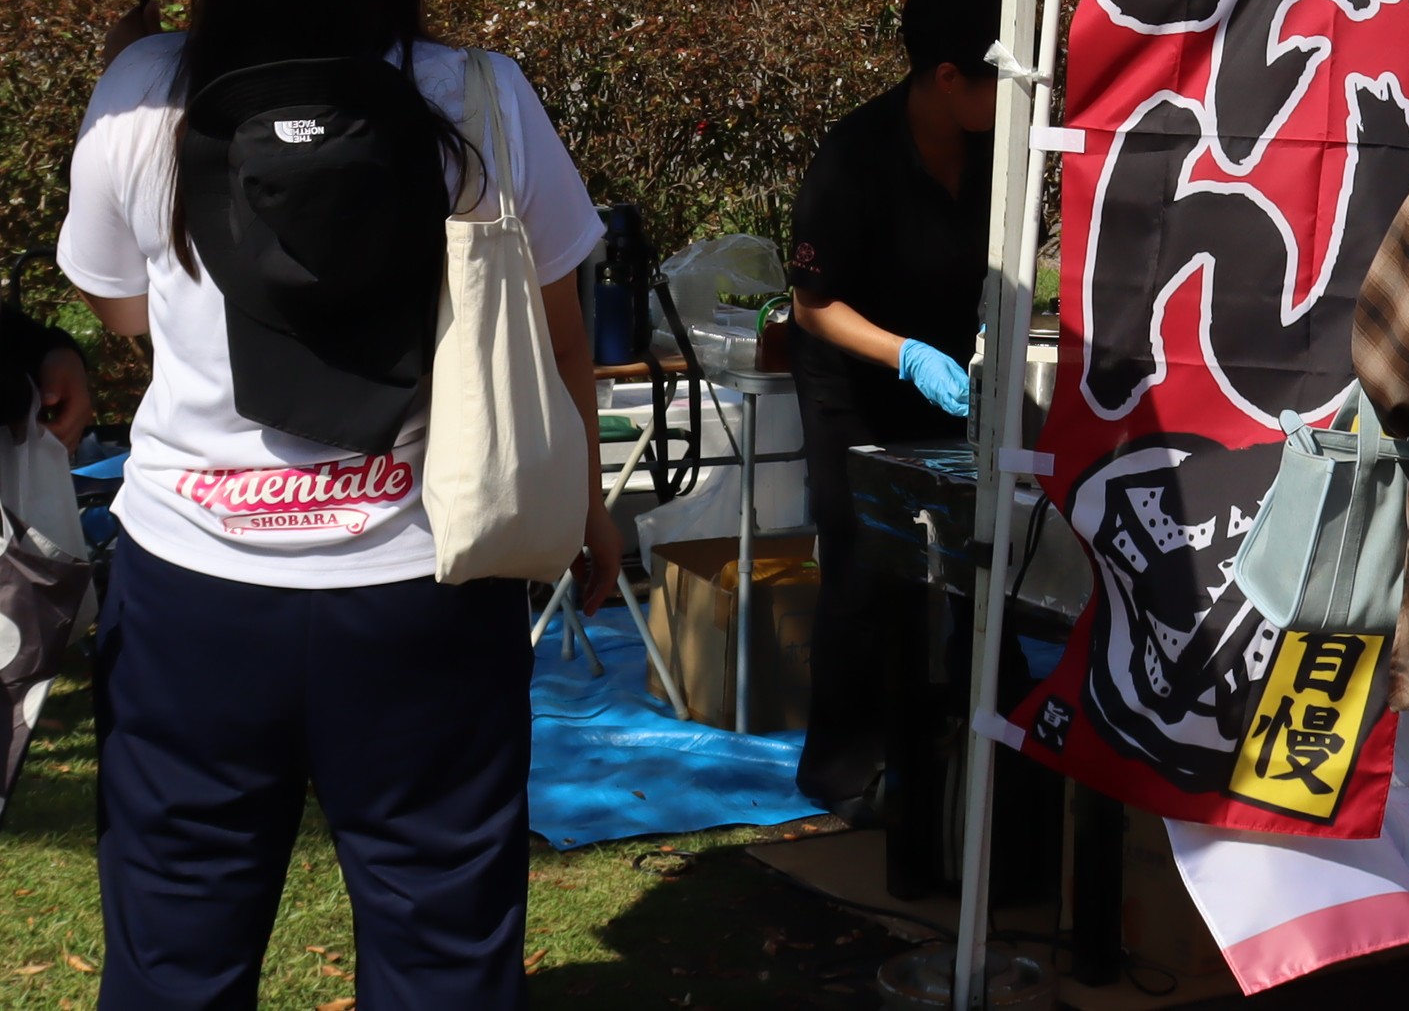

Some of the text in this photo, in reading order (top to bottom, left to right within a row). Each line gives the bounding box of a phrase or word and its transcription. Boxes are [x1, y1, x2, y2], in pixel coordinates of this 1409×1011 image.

[293, 119, 316, 128] FACE
[293, 126, 325, 135] NORTH
[293, 135, 312, 143] THE
[250, 512, 340, 528] SHOBARA
[1252, 632, 1368, 795] 自慢
